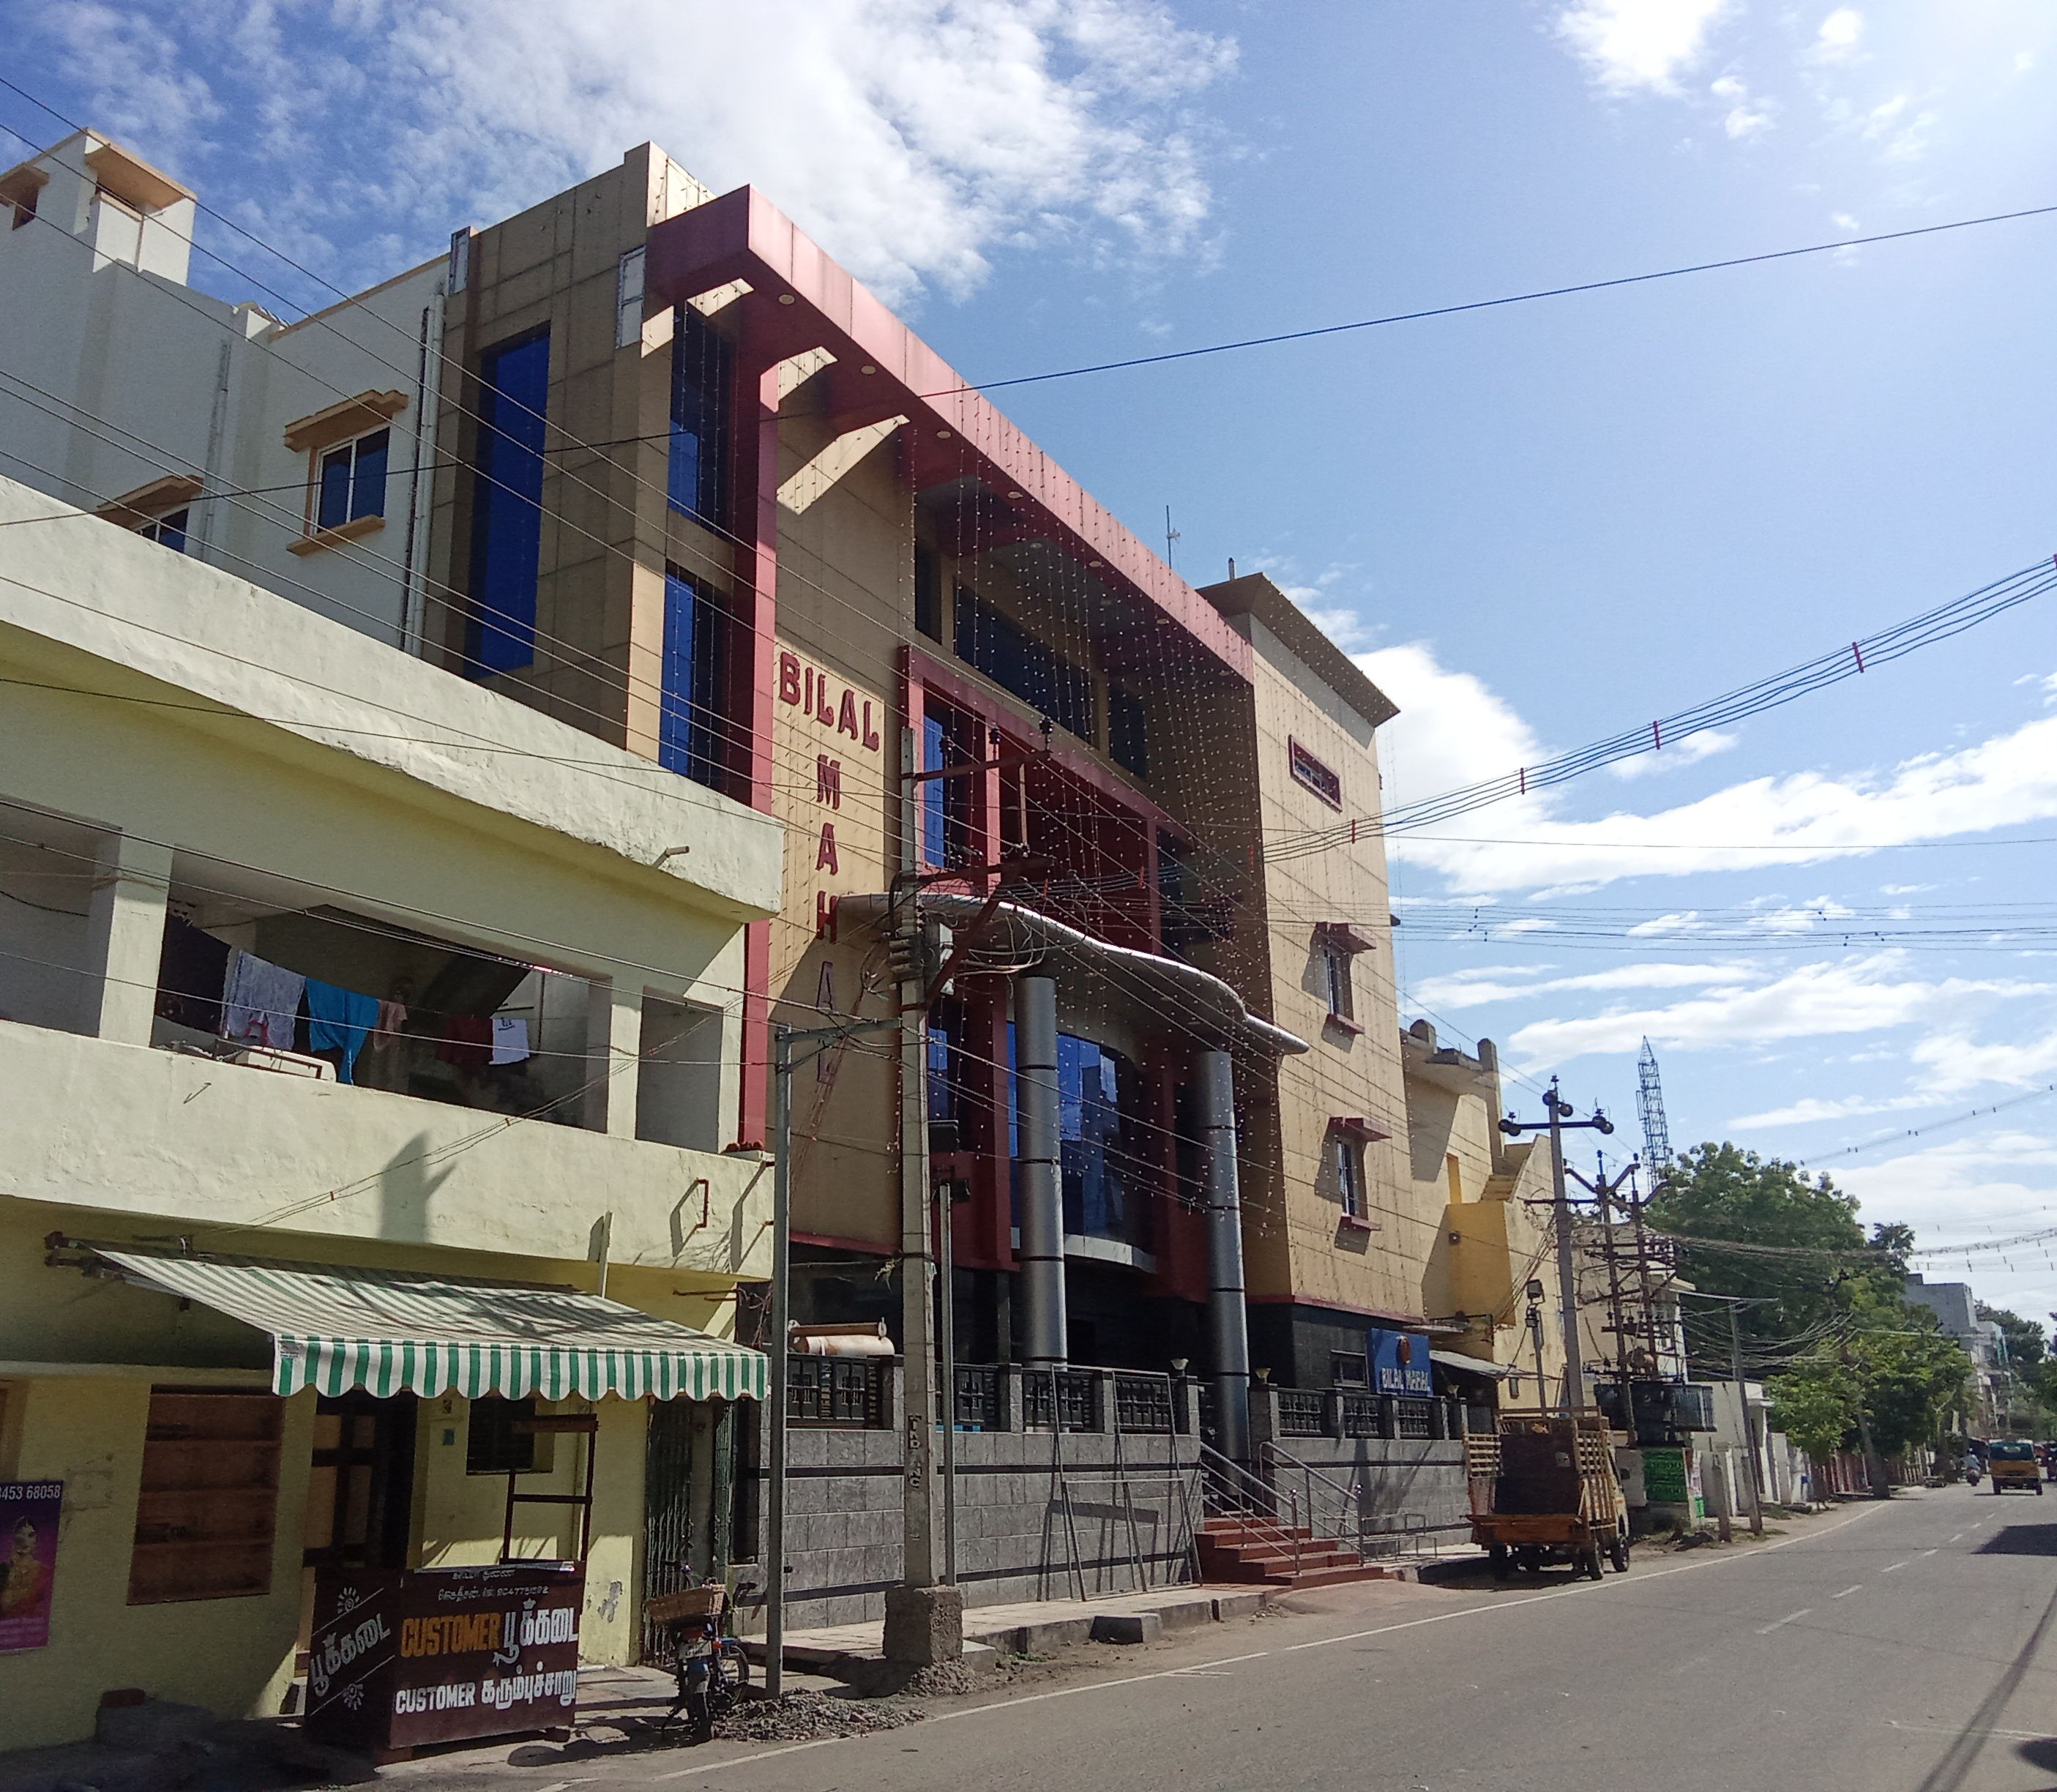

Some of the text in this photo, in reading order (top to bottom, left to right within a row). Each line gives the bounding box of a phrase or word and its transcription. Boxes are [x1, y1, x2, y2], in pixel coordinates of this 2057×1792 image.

[779, 652, 879, 752] BILAL
[0, 1485, 61, 1501] 453 68058
[310, 1613, 392, 1698] பூக்கடை
[400, 1598, 578, 1667] CUSTOMER பூக்கடை
[395, 1681, 476, 1714] CUSTOMER
